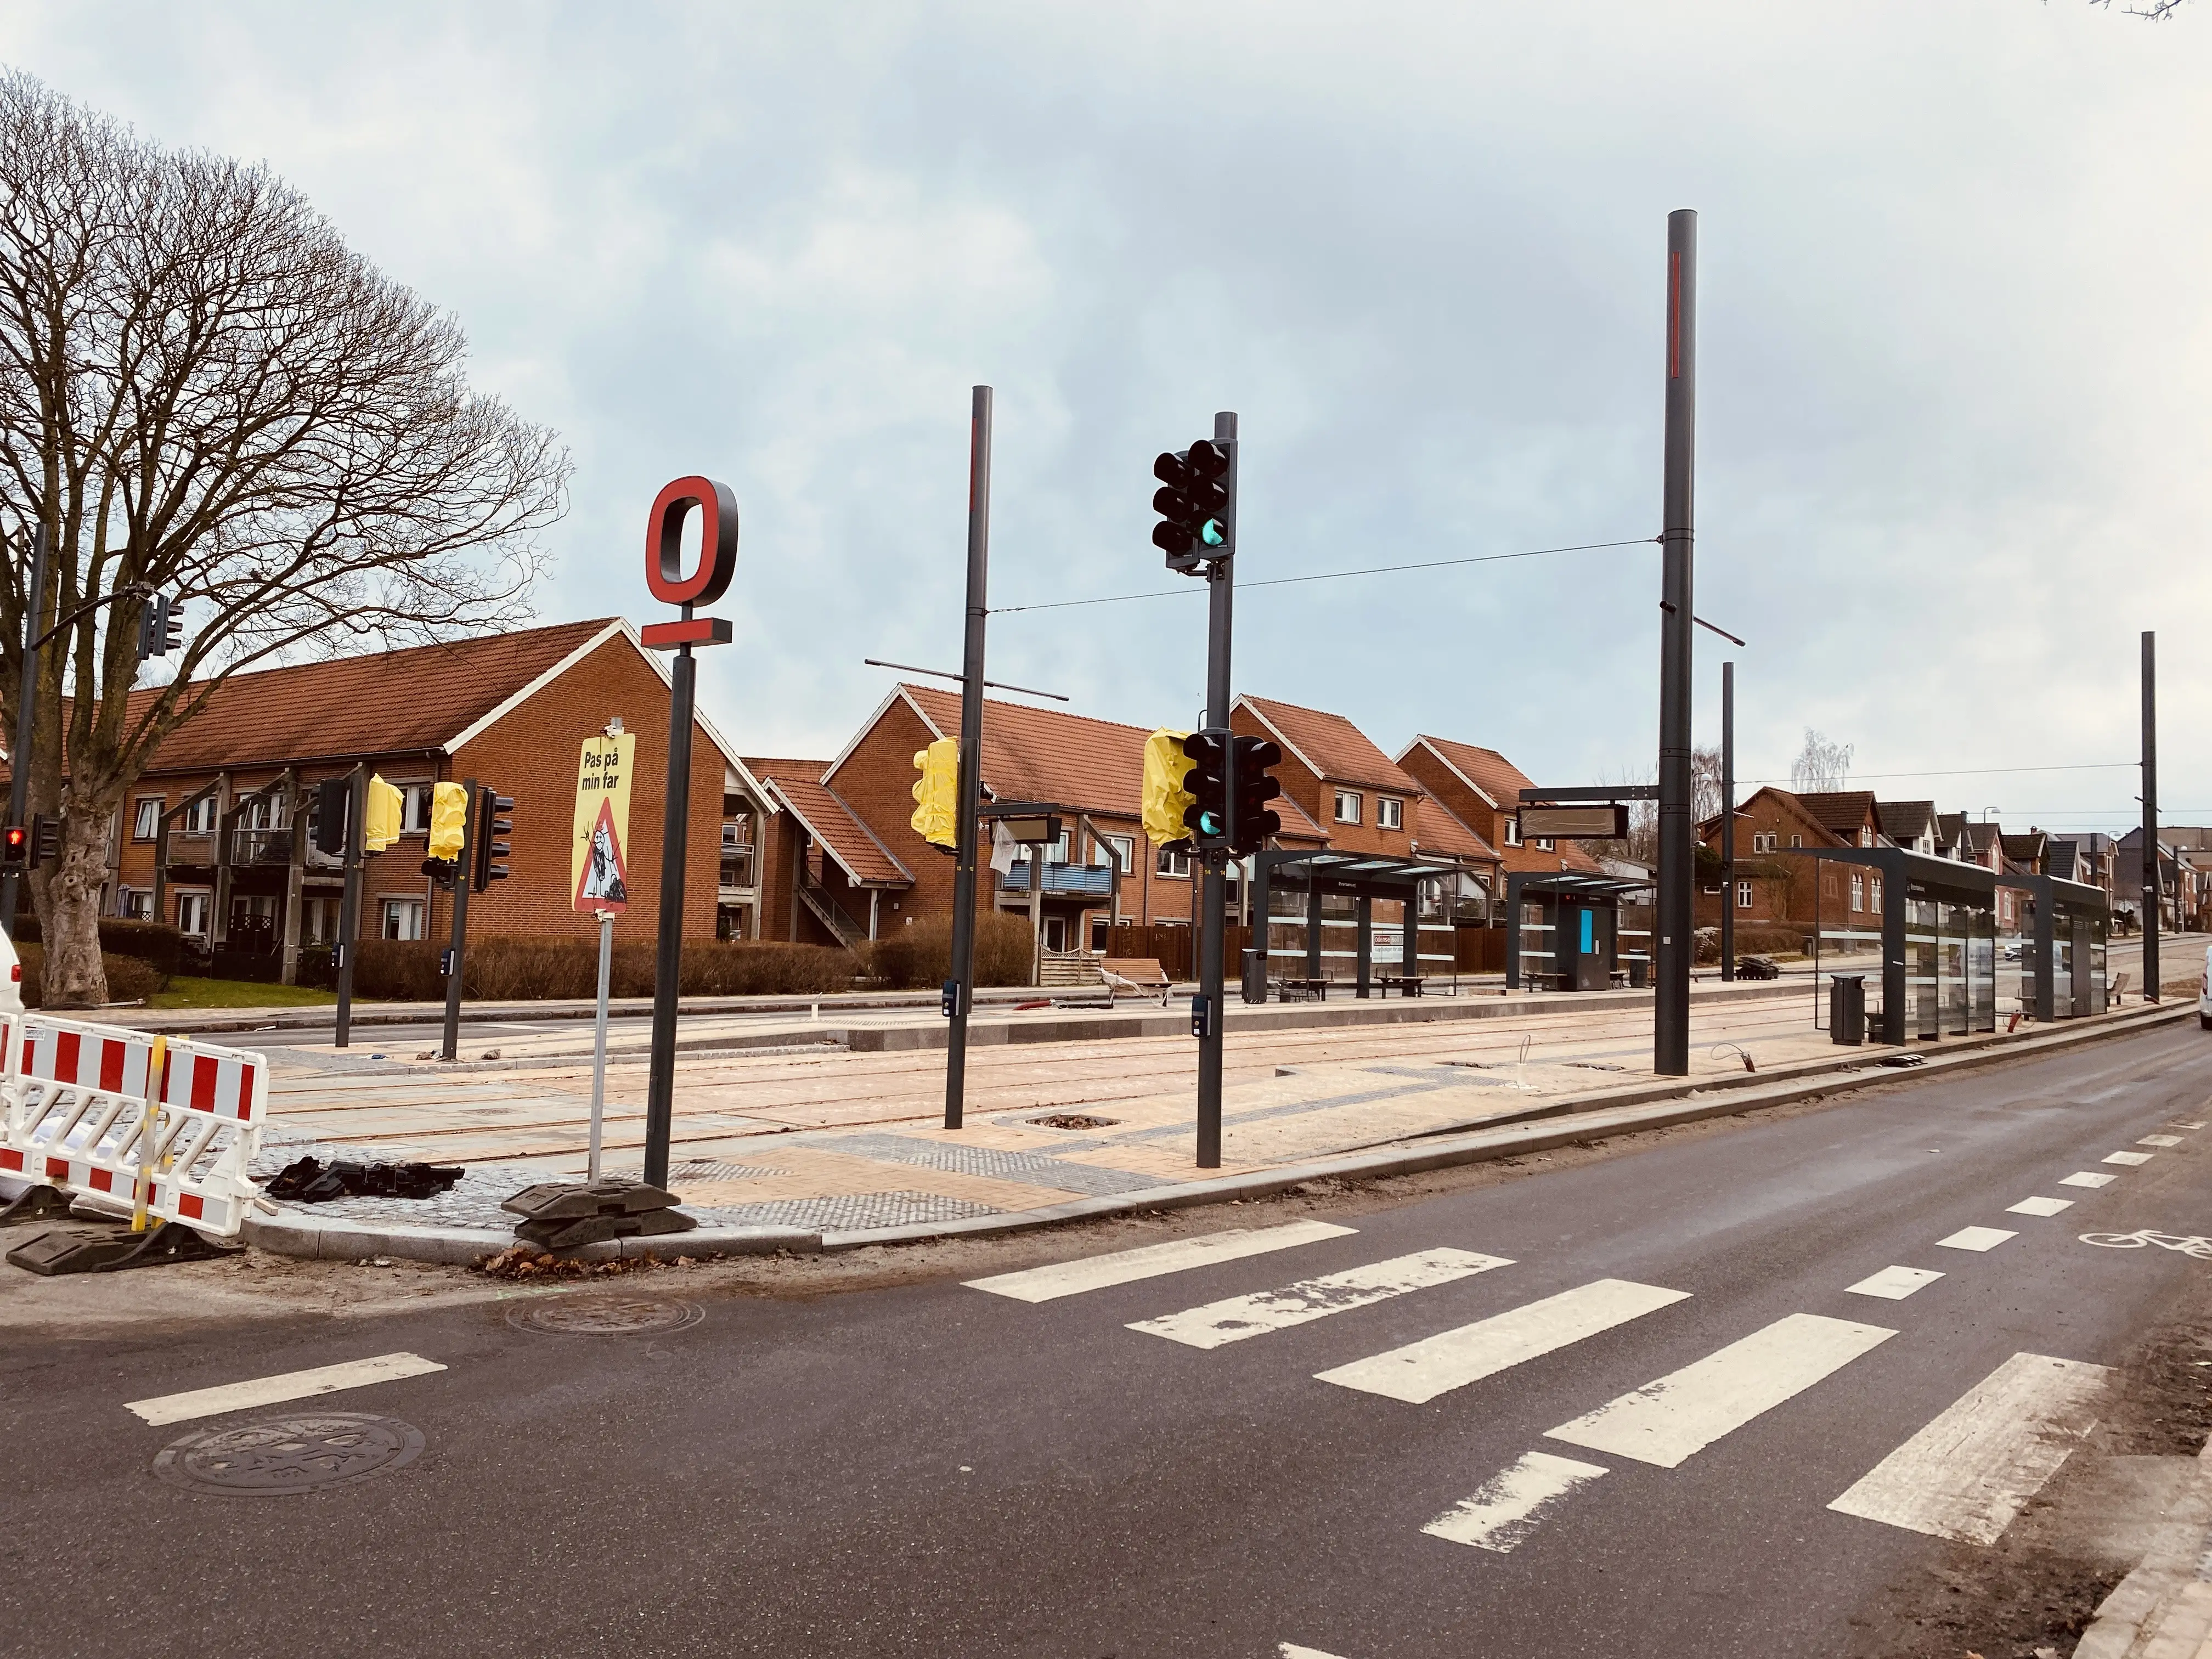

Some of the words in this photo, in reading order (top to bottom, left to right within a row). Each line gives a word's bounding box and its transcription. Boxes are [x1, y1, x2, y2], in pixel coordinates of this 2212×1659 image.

[584, 752, 601, 768] Pas
[604, 747, 619, 771] på
[582, 773, 600, 790] min
[603, 771, 619, 788] far
